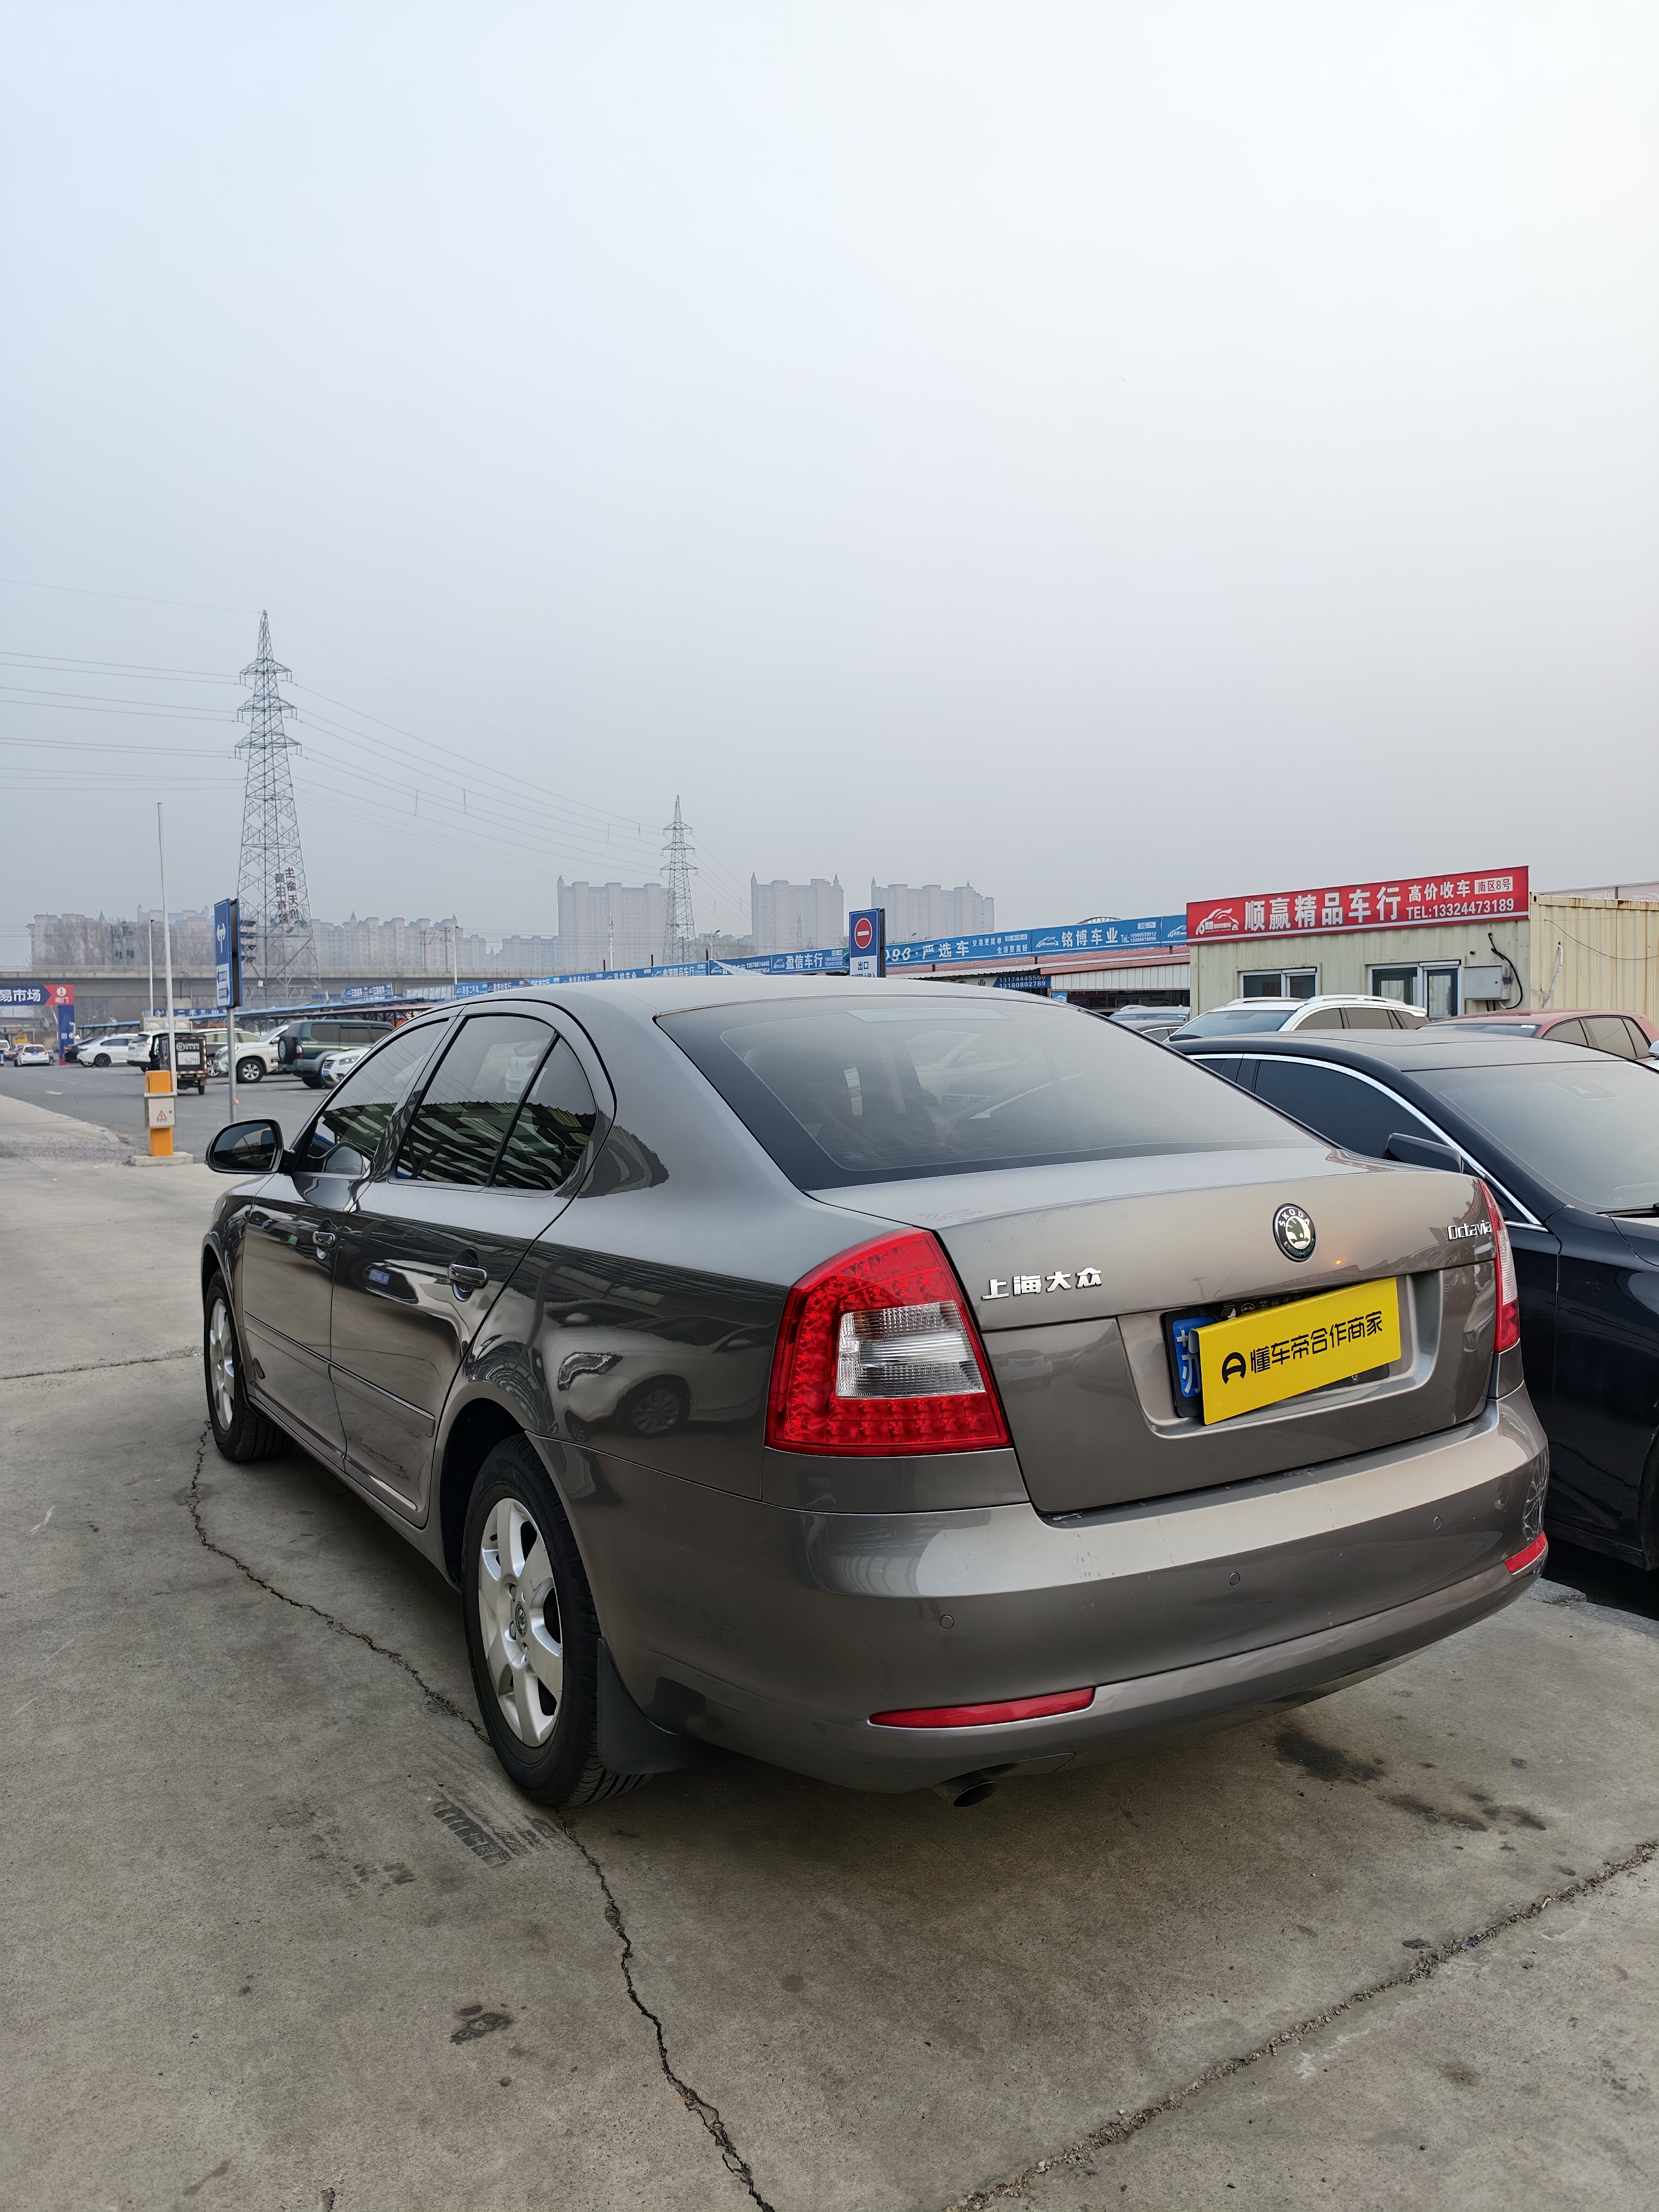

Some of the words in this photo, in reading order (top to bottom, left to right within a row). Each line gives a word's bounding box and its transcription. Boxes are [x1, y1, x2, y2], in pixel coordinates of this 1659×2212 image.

[1408, 879, 1471, 903] 高价收车
[1477, 878, 1510, 893] 南区8号
[1244, 886, 1401, 932] 顺赢精品车行
[1406, 898, 1514, 920] TEL:13324473189
[1061, 927, 1118, 948] 铭博车业
[786, 953, 823, 970] 盈信车行
[858, 961, 869, 971] 出口
[0, 988, 41, 1002] 易市场
[999, 980, 1046, 988] 13180802789
[1448, 1219, 1493, 1241] Octavia
[981, 1267, 1103, 1300] 上海大众
[1250, 1310, 1382, 1374] 懂车帝合作商家
